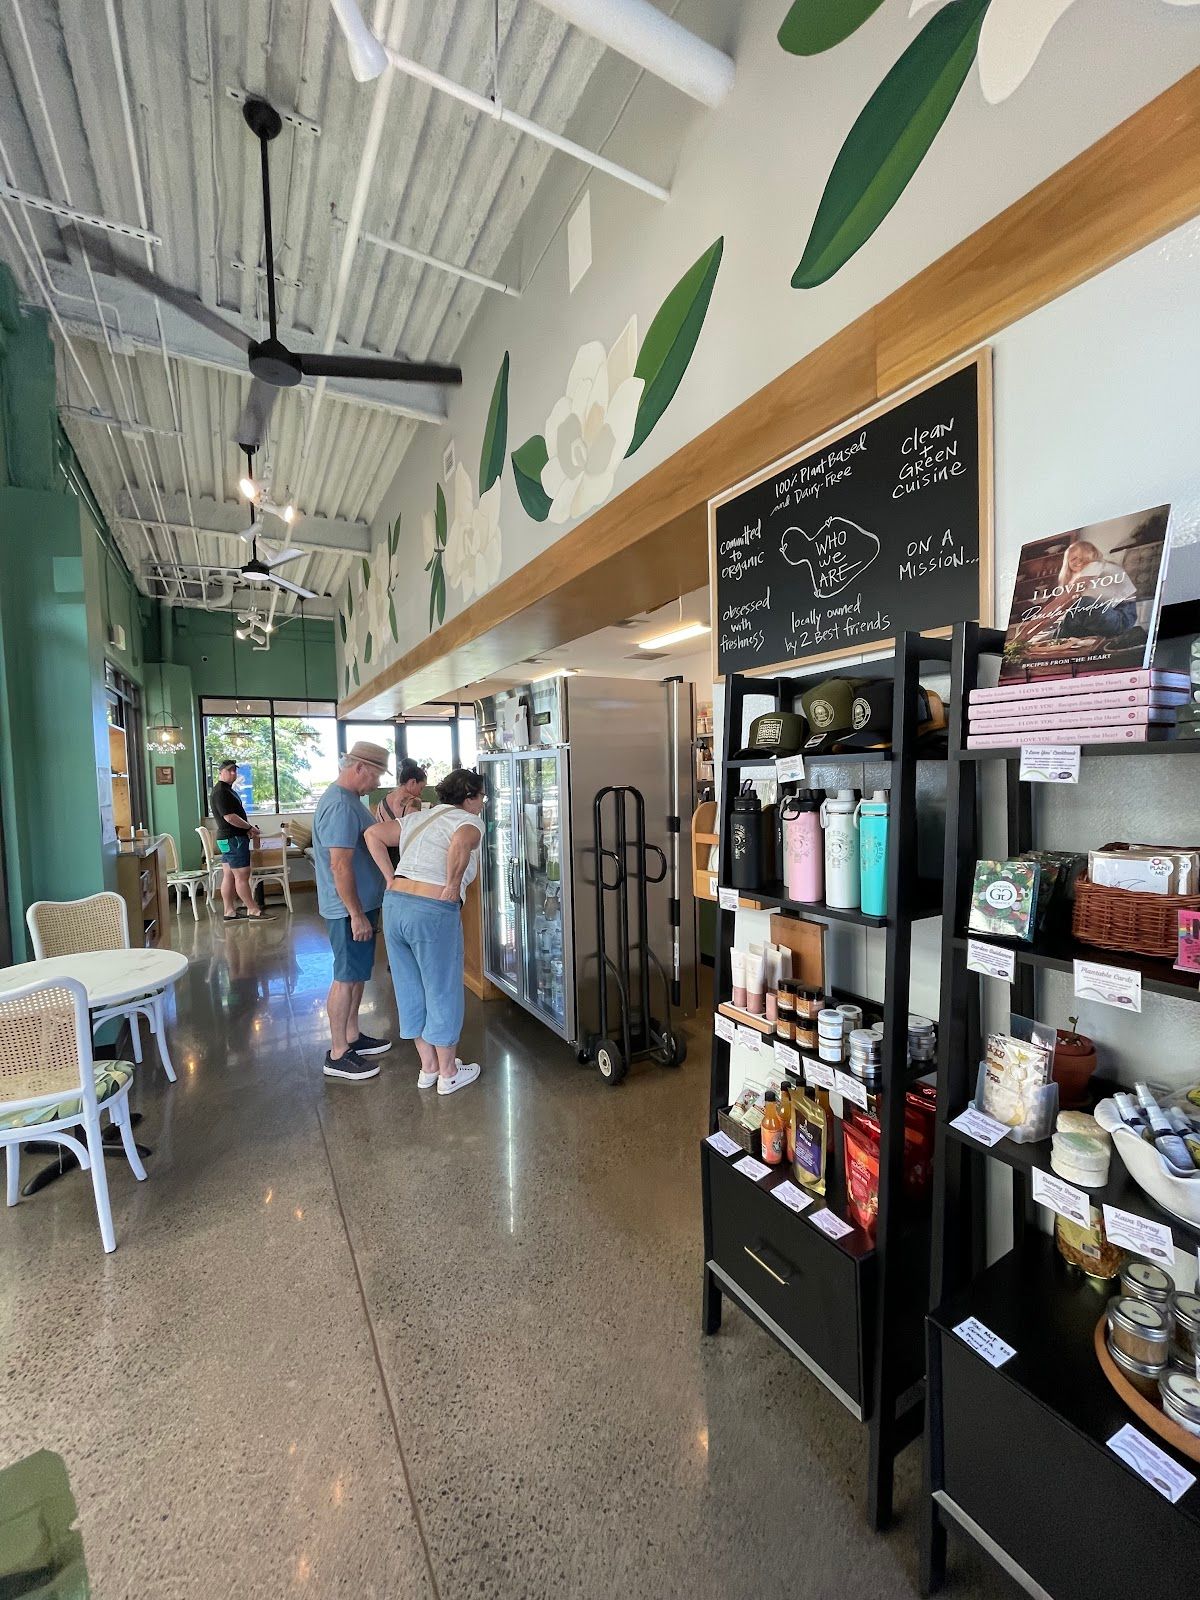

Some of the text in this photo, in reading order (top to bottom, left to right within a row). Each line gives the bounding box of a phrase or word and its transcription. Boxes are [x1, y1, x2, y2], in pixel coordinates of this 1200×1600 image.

[776, 474, 798, 498] 100%
[720, 518, 761, 555] committed
[815, 530, 846, 556] WHO
[908, 529, 953, 556] ON A
[730, 551, 741, 562] to
[819, 561, 848, 587] ARE
[1033, 571, 1126, 601] I LOVE YOU
[723, 586, 770, 621] obsessed
[791, 593, 861, 633] locally owned
[731, 618, 751, 633] with
[784, 639, 798, 655] by
[800, 633, 813, 648] 2
[843, 612, 891, 635] friends
[720, 630, 765, 653] freshness
[1022, 660, 1048, 669] RECIPES
[1050, 658, 1070, 666] FROM
[1087, 653, 1111, 662] HEART
[1135, 1219, 1159, 1234] Spray
